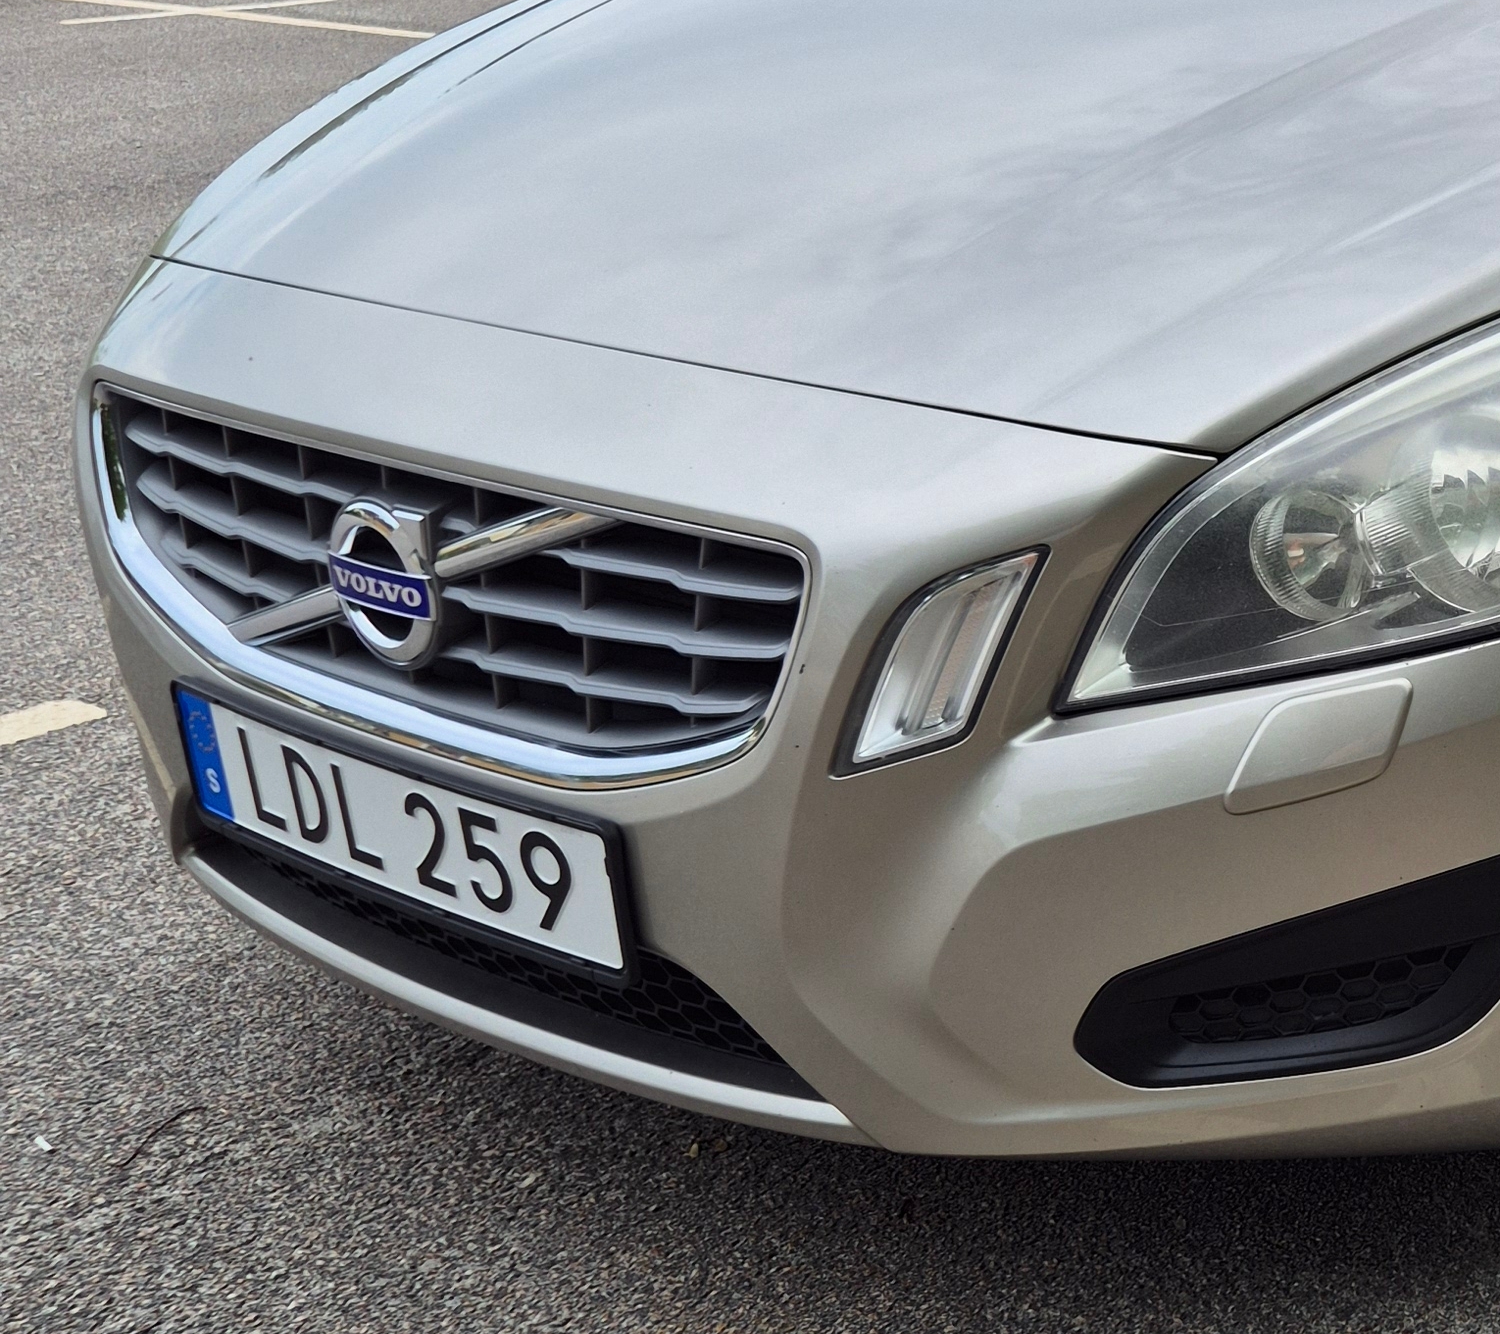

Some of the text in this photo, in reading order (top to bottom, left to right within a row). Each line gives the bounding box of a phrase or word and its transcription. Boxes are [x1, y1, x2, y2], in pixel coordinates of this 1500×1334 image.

[333, 564, 422, 607] VOLVO
[205, 767, 221, 793] S
[236, 726, 572, 931] LDL 259
